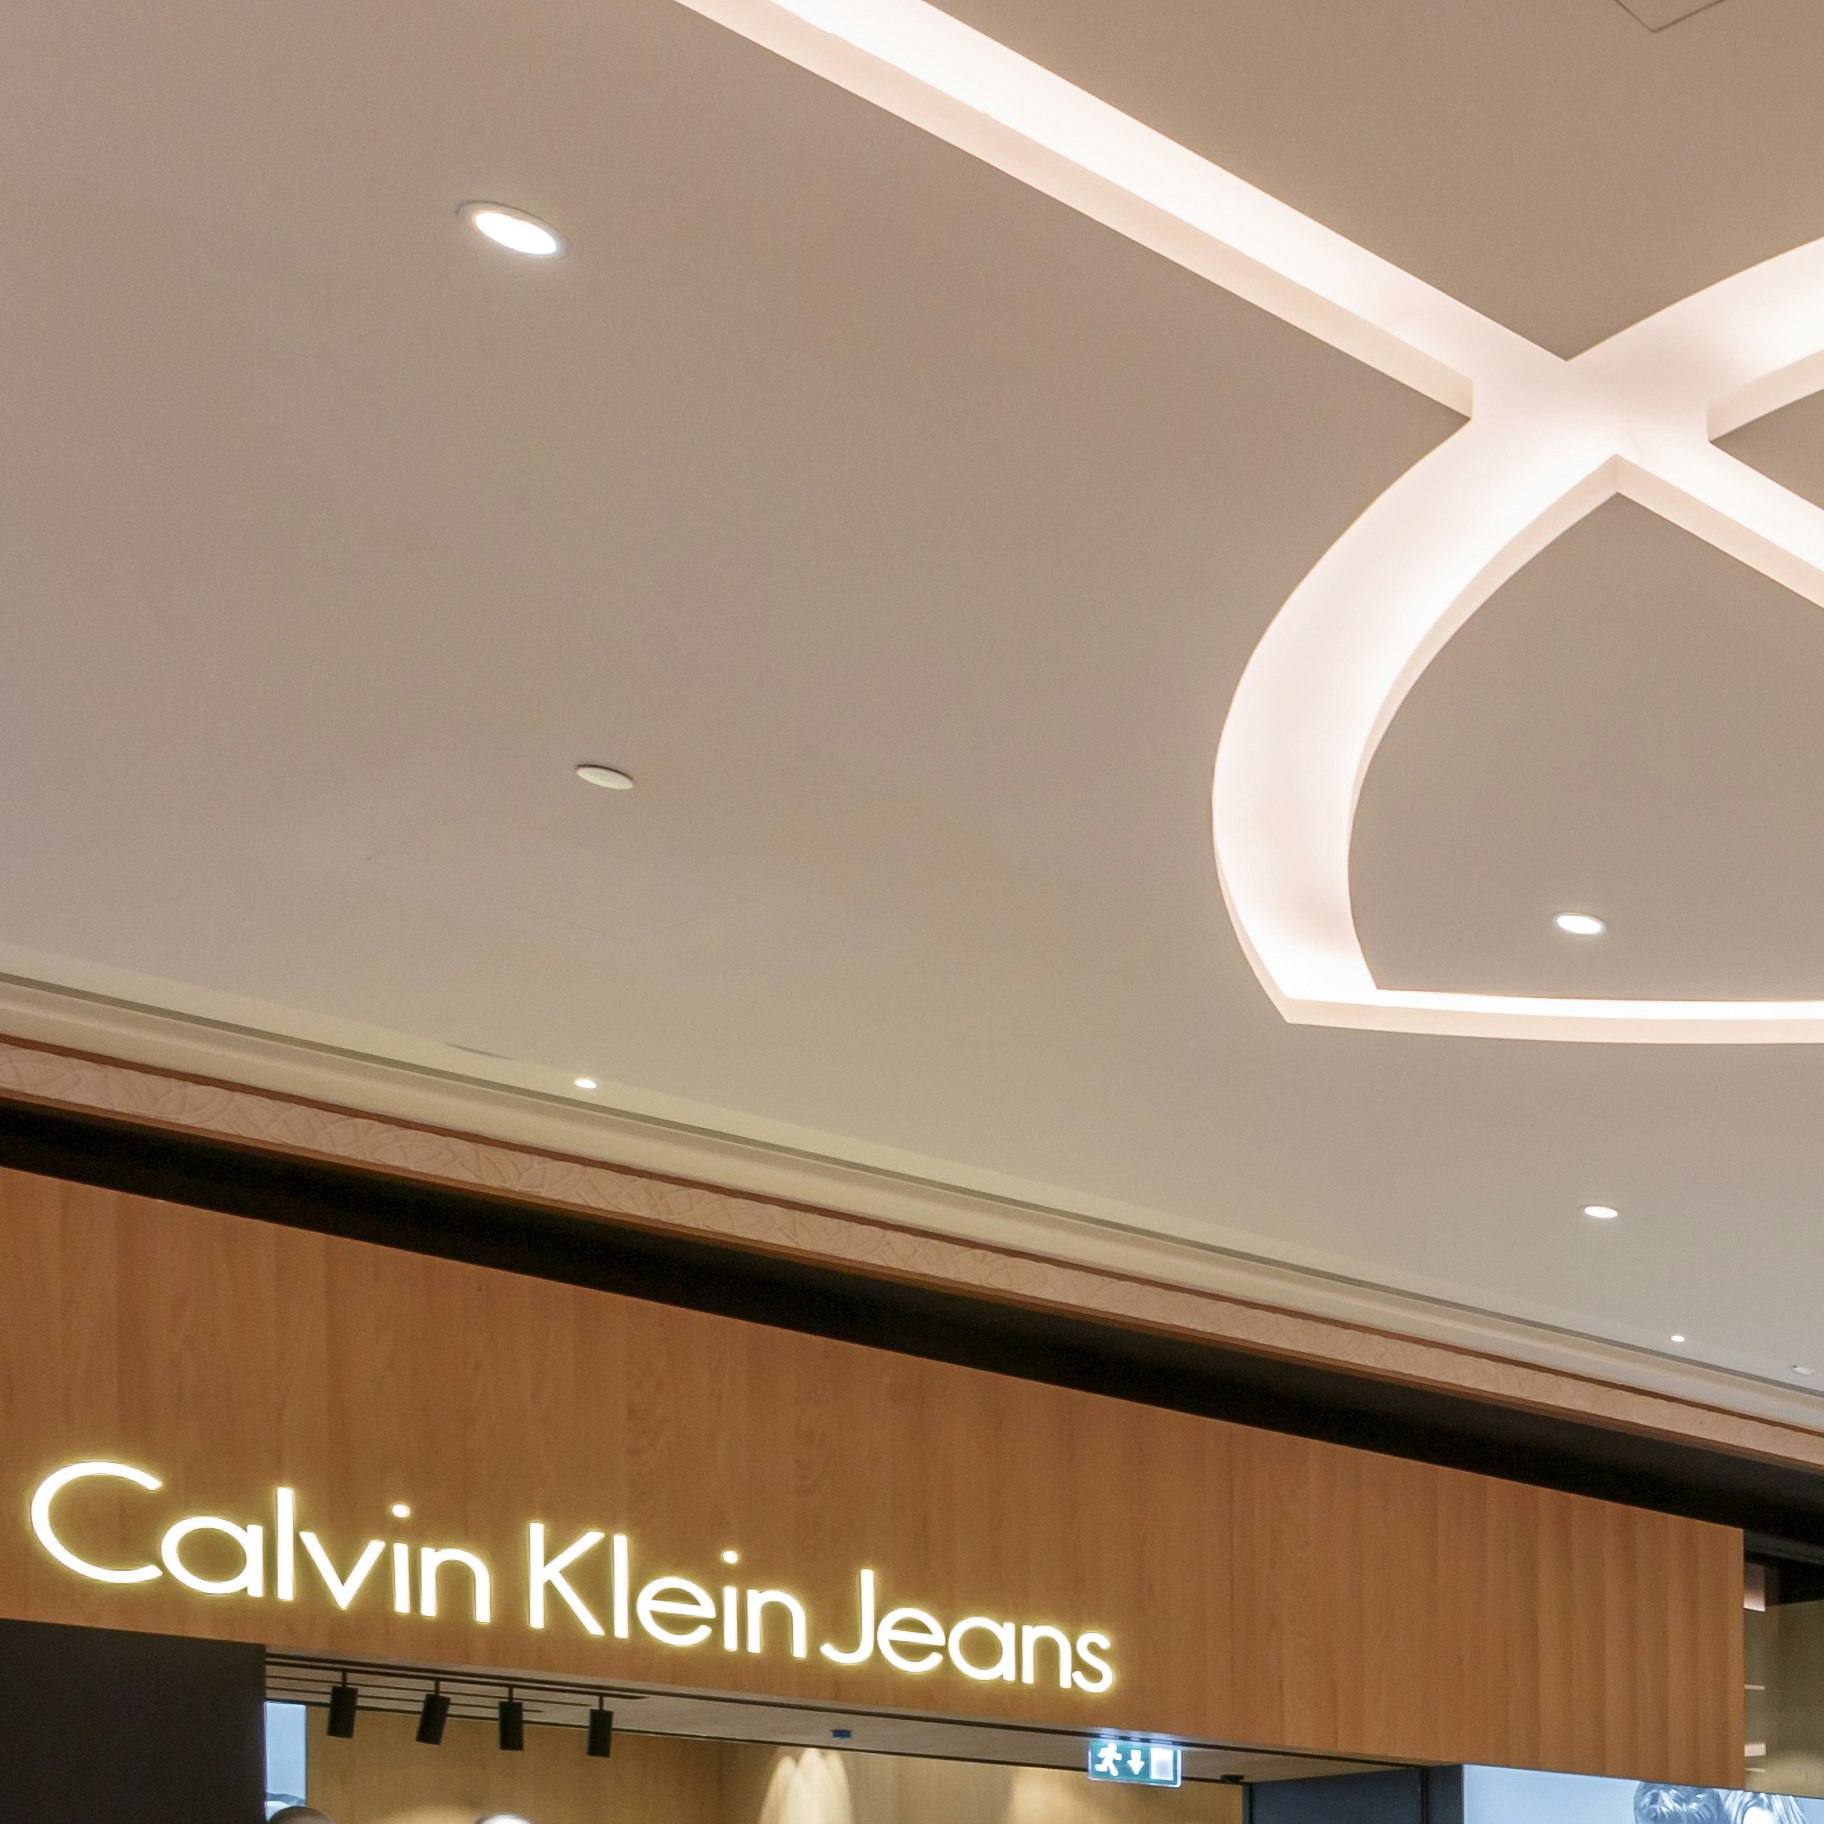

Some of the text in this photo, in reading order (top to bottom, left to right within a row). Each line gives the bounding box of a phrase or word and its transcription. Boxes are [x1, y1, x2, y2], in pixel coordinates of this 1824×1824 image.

[31, 1460, 1113, 1693] Calvin Klein Jeans
